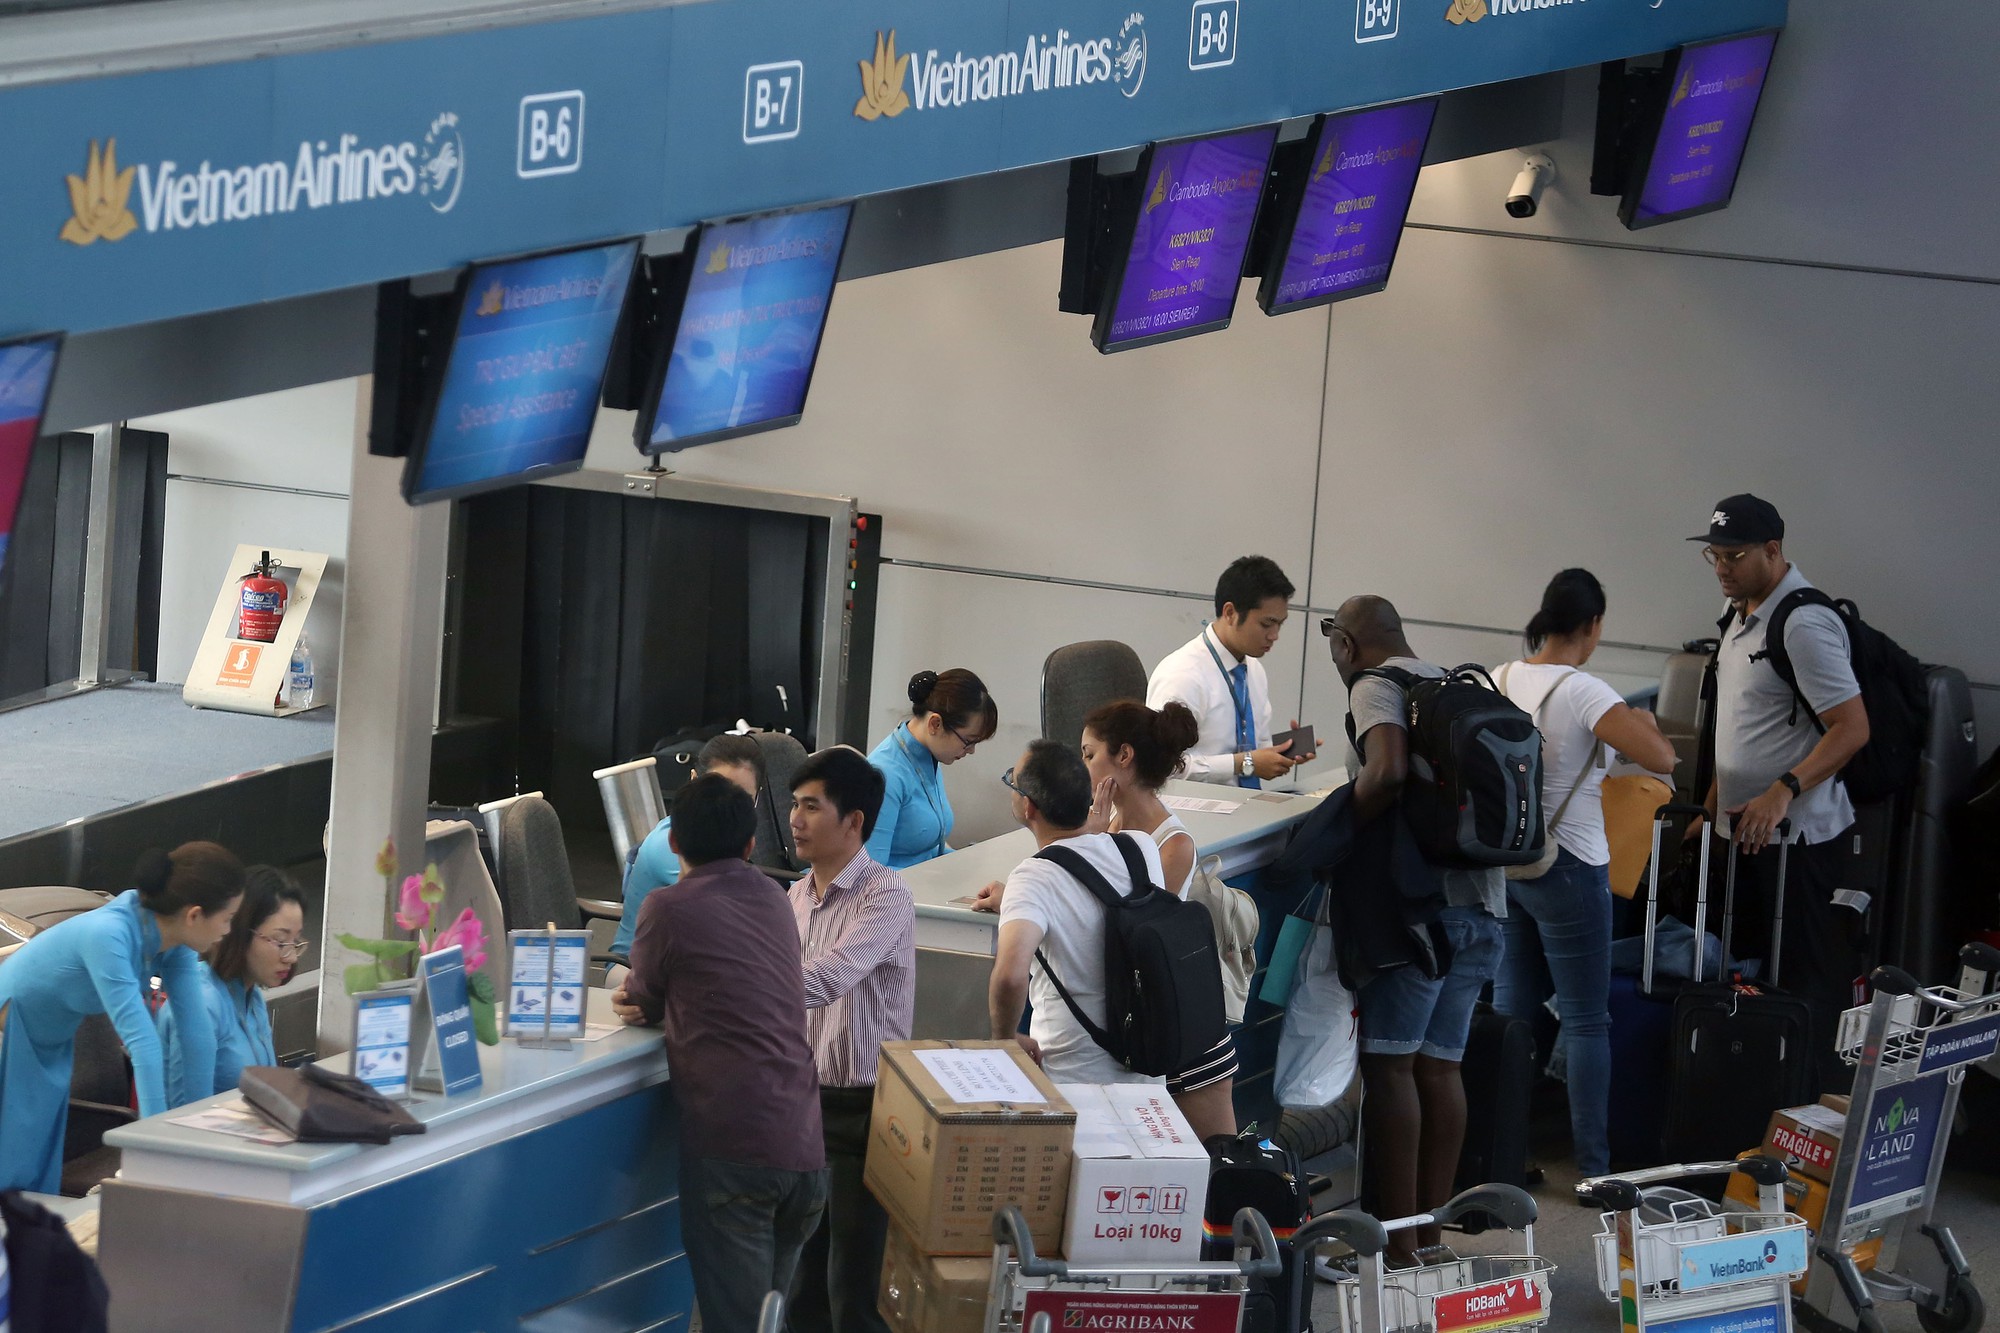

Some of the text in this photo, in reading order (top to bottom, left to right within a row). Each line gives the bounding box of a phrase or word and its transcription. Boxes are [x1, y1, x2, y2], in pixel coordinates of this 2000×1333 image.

[1198, 9, 1228, 56] B-8
[755, 76, 792, 129] B-7
[529, 106, 572, 163] B-6
[1335, 151, 1375, 171] Cambodia
[1169, 181, 1211, 202] Cambodia
[1210, 176, 1239, 198] Angkor
[1170, 255, 1201, 272] Siem Reap
[1148, 284, 1174, 302] Departure
[1960, 1029, 1998, 1048] NOVALAND
[1772, 1126, 1821, 1163] FRAGILE
[1867, 1133, 1916, 1161] LAND
[1094, 1223, 1182, 1243] Loại 10kg
[1710, 1256, 1765, 1278] VietinBank
[1466, 1292, 1506, 1313] HDBank
[1085, 1315, 1196, 1330] AGRIBANK
